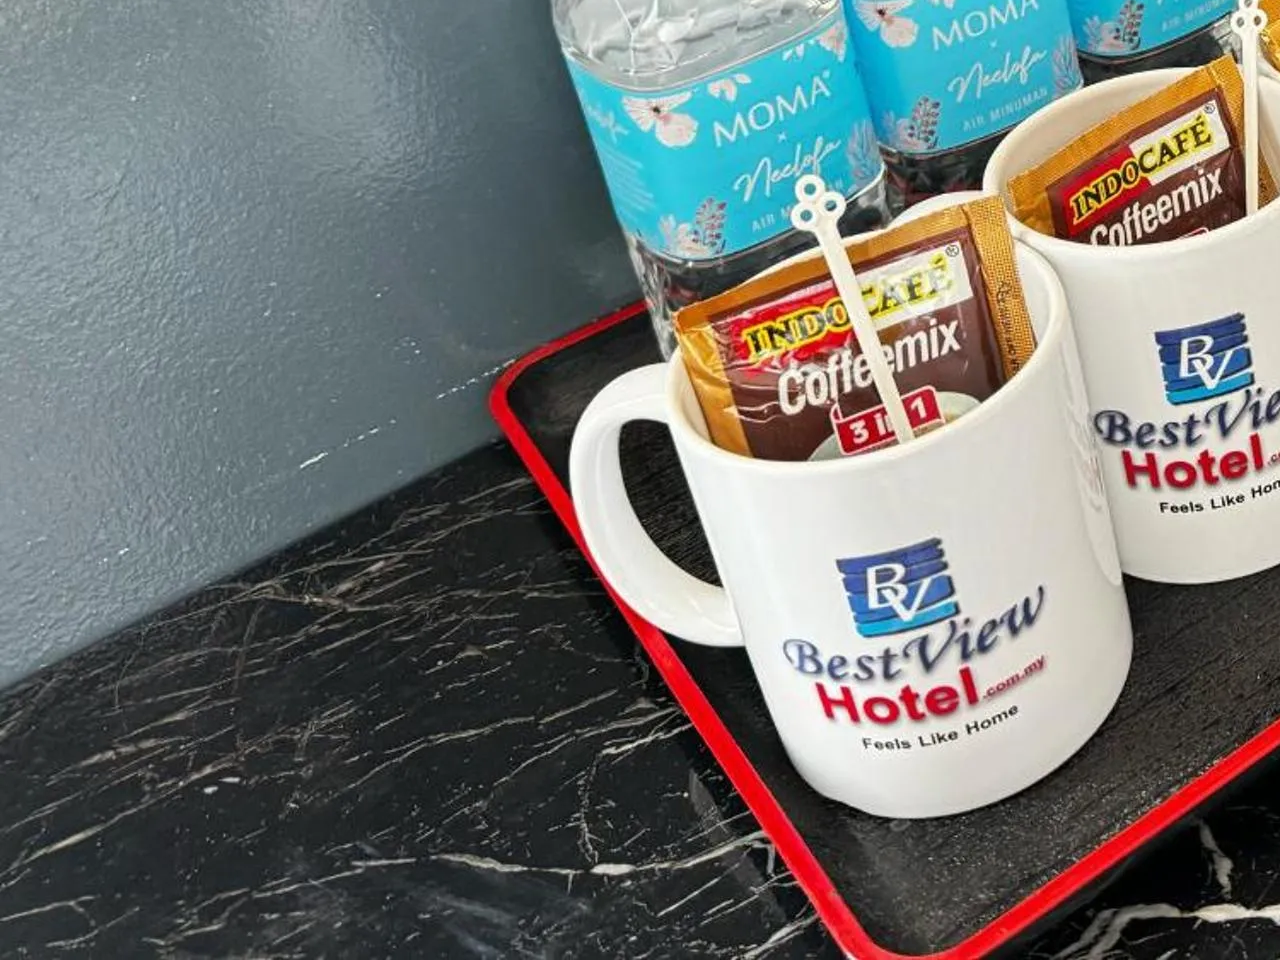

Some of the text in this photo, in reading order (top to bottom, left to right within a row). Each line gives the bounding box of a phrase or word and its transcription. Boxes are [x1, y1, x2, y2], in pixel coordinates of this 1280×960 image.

[713, 75, 832, 147] MOMA
[1070, 113, 1214, 225] INDOCAFÉ
[752, 213, 775, 233] AIR
[851, 422, 871, 447] 3
[910, 395, 928, 420] 1
[1159, 501, 1204, 514] Feels
[1210, 494, 1245, 510] Like
[862, 705, 1019, 751] Feels Like Home
